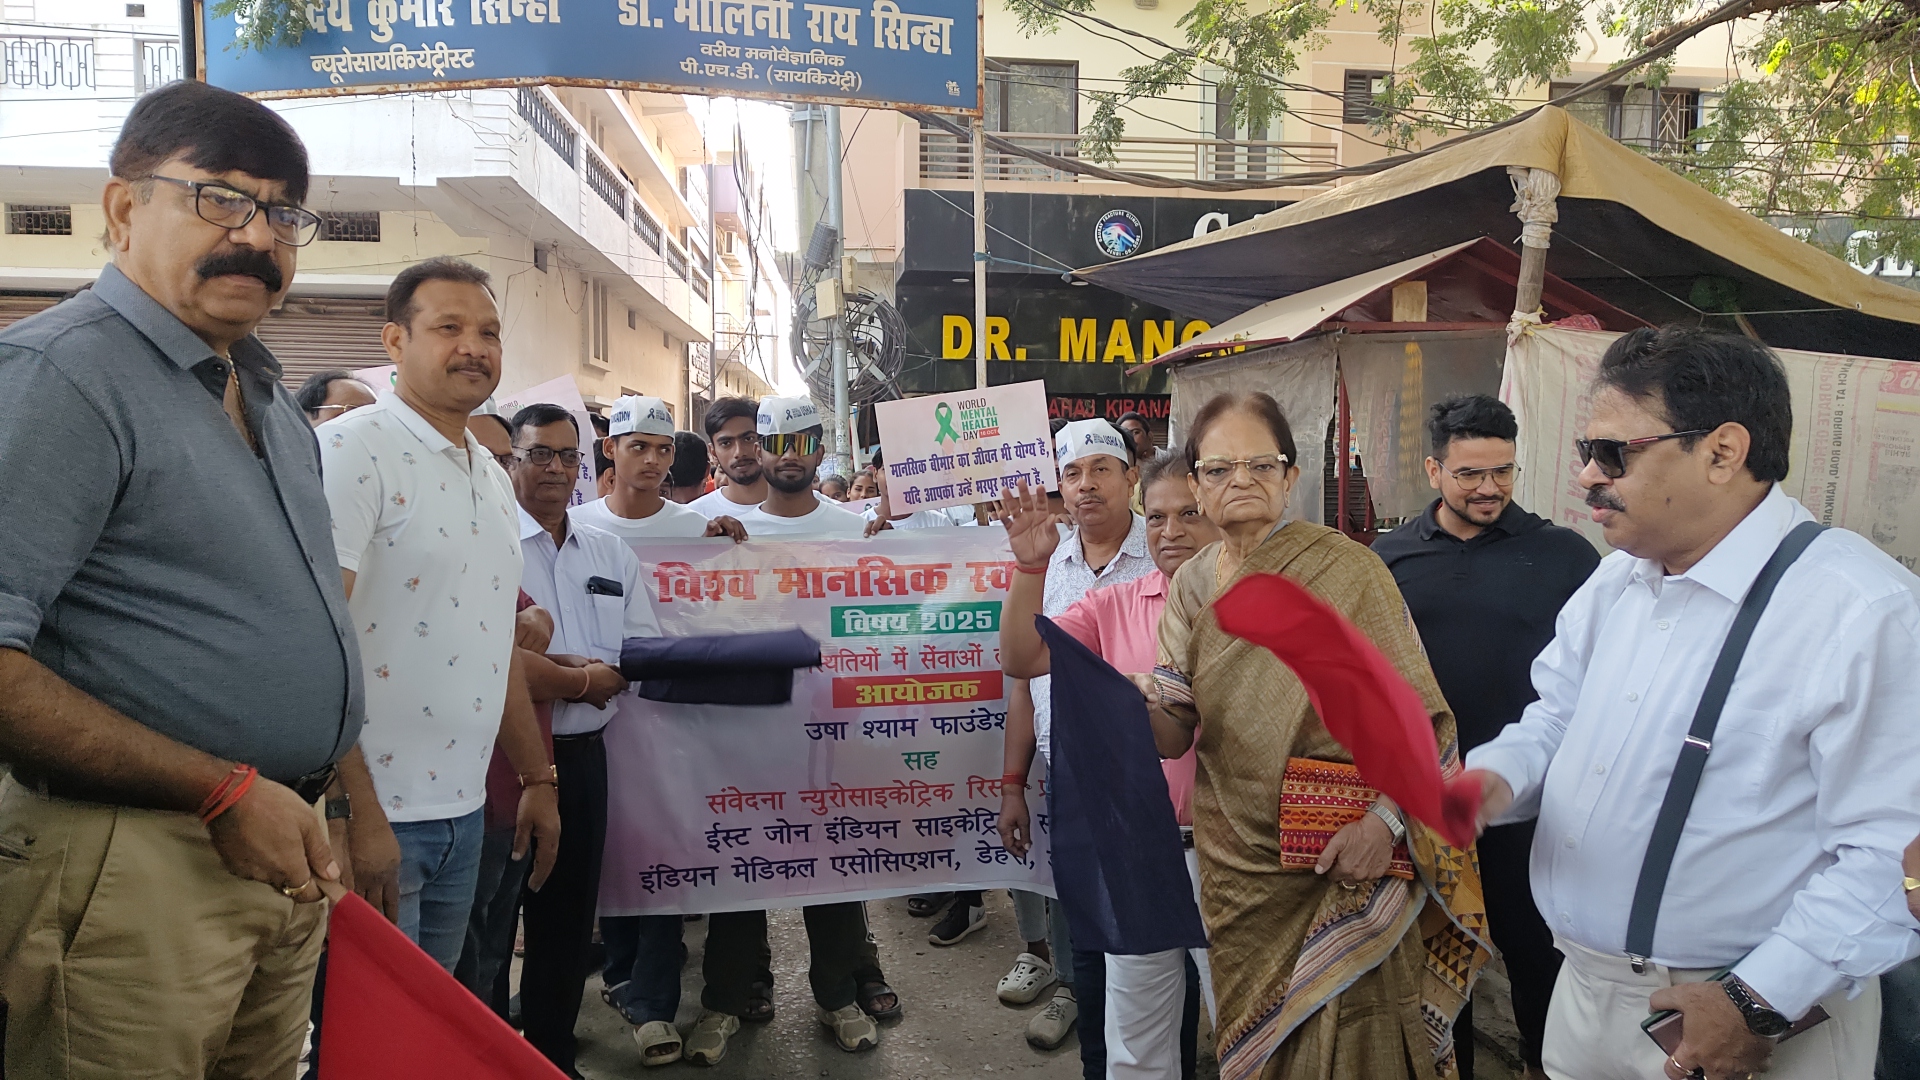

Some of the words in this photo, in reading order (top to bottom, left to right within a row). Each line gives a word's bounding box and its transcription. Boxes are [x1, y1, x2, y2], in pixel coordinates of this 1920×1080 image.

[803, 3, 863, 46] राय
[870, 0, 955, 55] सिन्हा
[700, 41, 742, 59] वरीय
[745, 45, 846, 68] मनोवैज्ञानिक
[942, 314, 1027, 361] DR.
[957, 398, 987, 410] WORLD
[960, 406, 998, 421] MENTAL
[1048, 399, 1096, 418] AHAJ
[1105, 399, 1171, 419] KIRANA
[961, 417, 998, 431] HEALTH
[963, 430, 979, 441] DAY
[890, 457, 927, 478] मानसिक
[928, 452, 955, 472] बीमार
[956, 451, 970, 467] का
[972, 447, 998, 466] जीवन
[1014, 441, 1037, 459] योग्य
[903, 487, 922, 505] यदि
[923, 484, 954, 502] आपका
[956, 477, 973, 497] उन्हें
[653, 561, 758, 603] विश्व
[773, 556, 952, 599] मानसिक
[842, 610, 909, 634] विषय
[921, 610, 992, 630] 2025
[891, 646, 908, 668] में
[855, 678, 979, 704] आयोजक
[805, 720, 849, 742] उषा
[862, 716, 918, 739] श्याम
[902, 750, 940, 771] सह
[706, 786, 786, 814] संवेदना
[966, 774, 1003, 799] रिस
[705, 825, 752, 854] ईस्ट
[764, 818, 810, 843] जोन
[825, 816, 899, 844] इंडियन
[915, 807, 1000, 837] साइकेट्रि
[639, 866, 716, 894] इंडियन
[734, 855, 818, 882] मेडिकल
[831, 847, 962, 876] एसोसिएशन,
